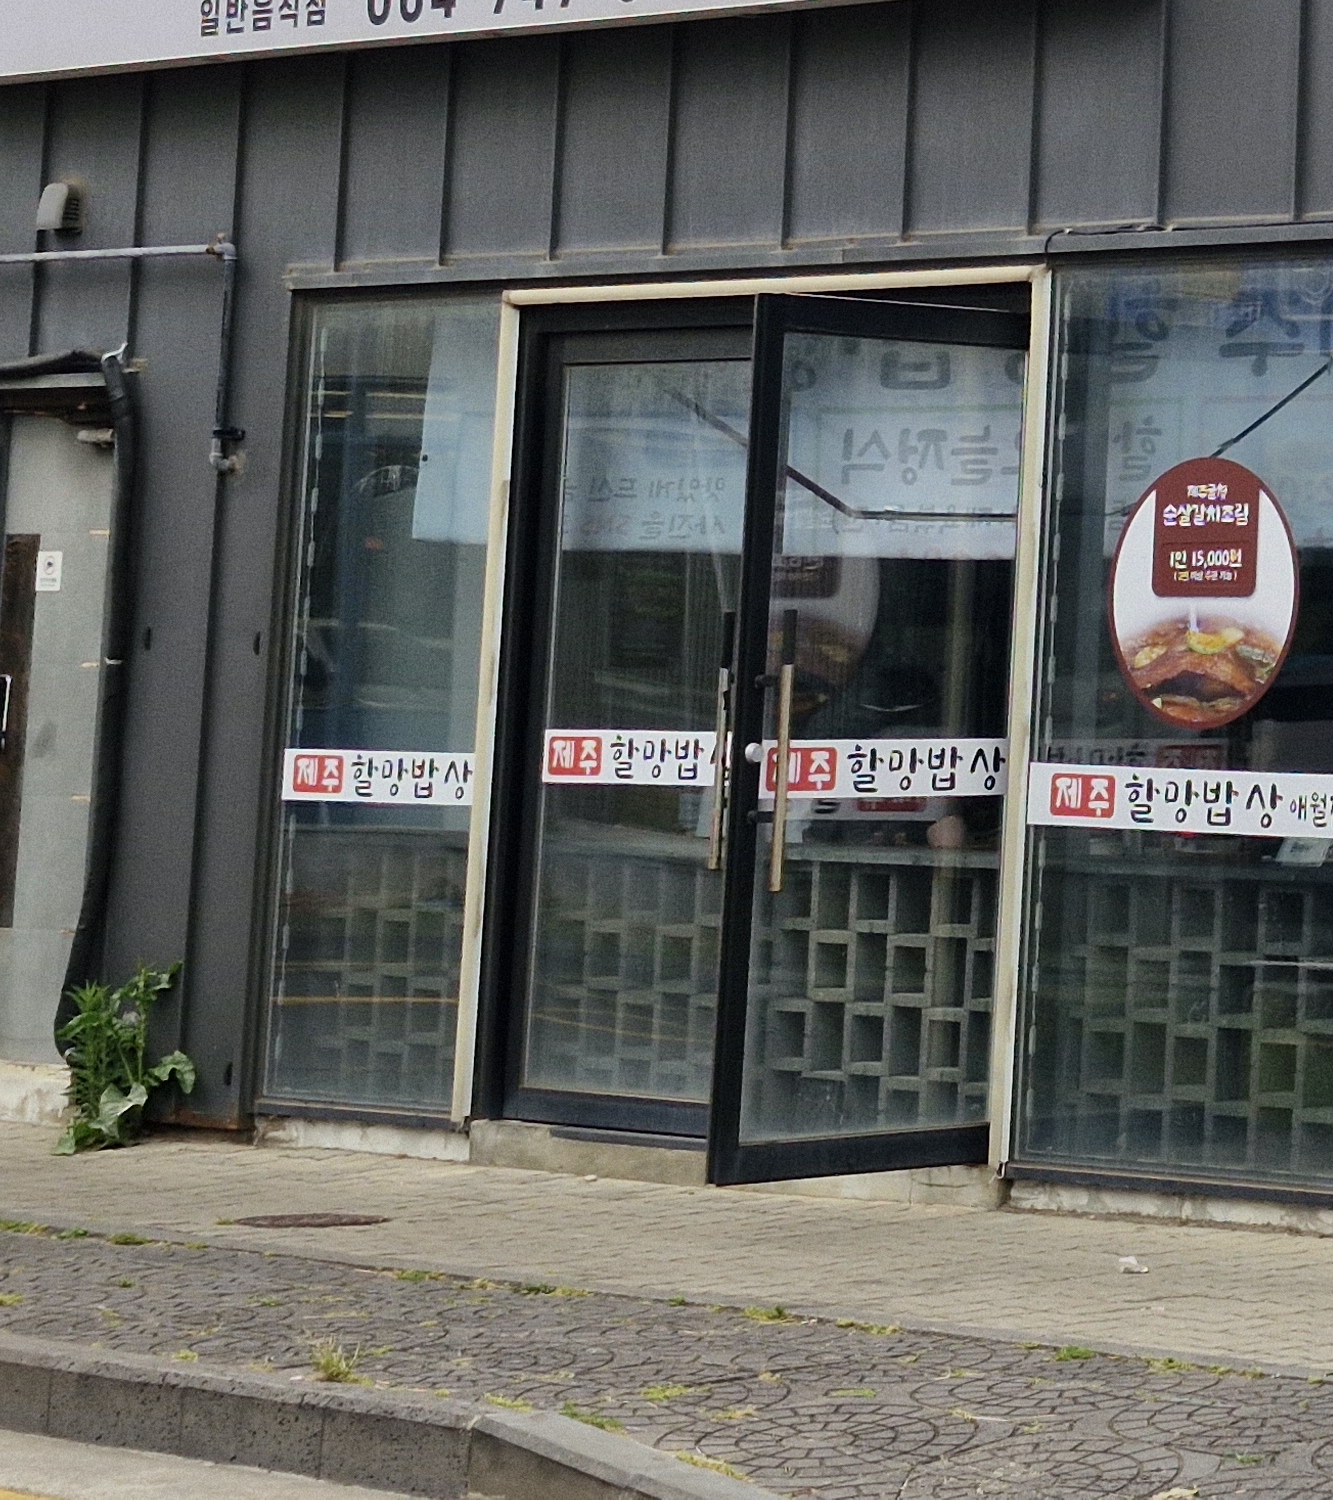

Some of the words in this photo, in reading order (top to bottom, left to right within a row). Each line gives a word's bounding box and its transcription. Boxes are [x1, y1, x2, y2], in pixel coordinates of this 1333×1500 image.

[295, 756, 342, 793] 제주
[351, 753, 474, 800] 할망밥상
[550, 738, 600, 776] 제주
[846, 744, 1006, 793] 할망밥상
[1053, 775, 1113, 817] 제주
[1124, 773, 1284, 829] 할망밥상
